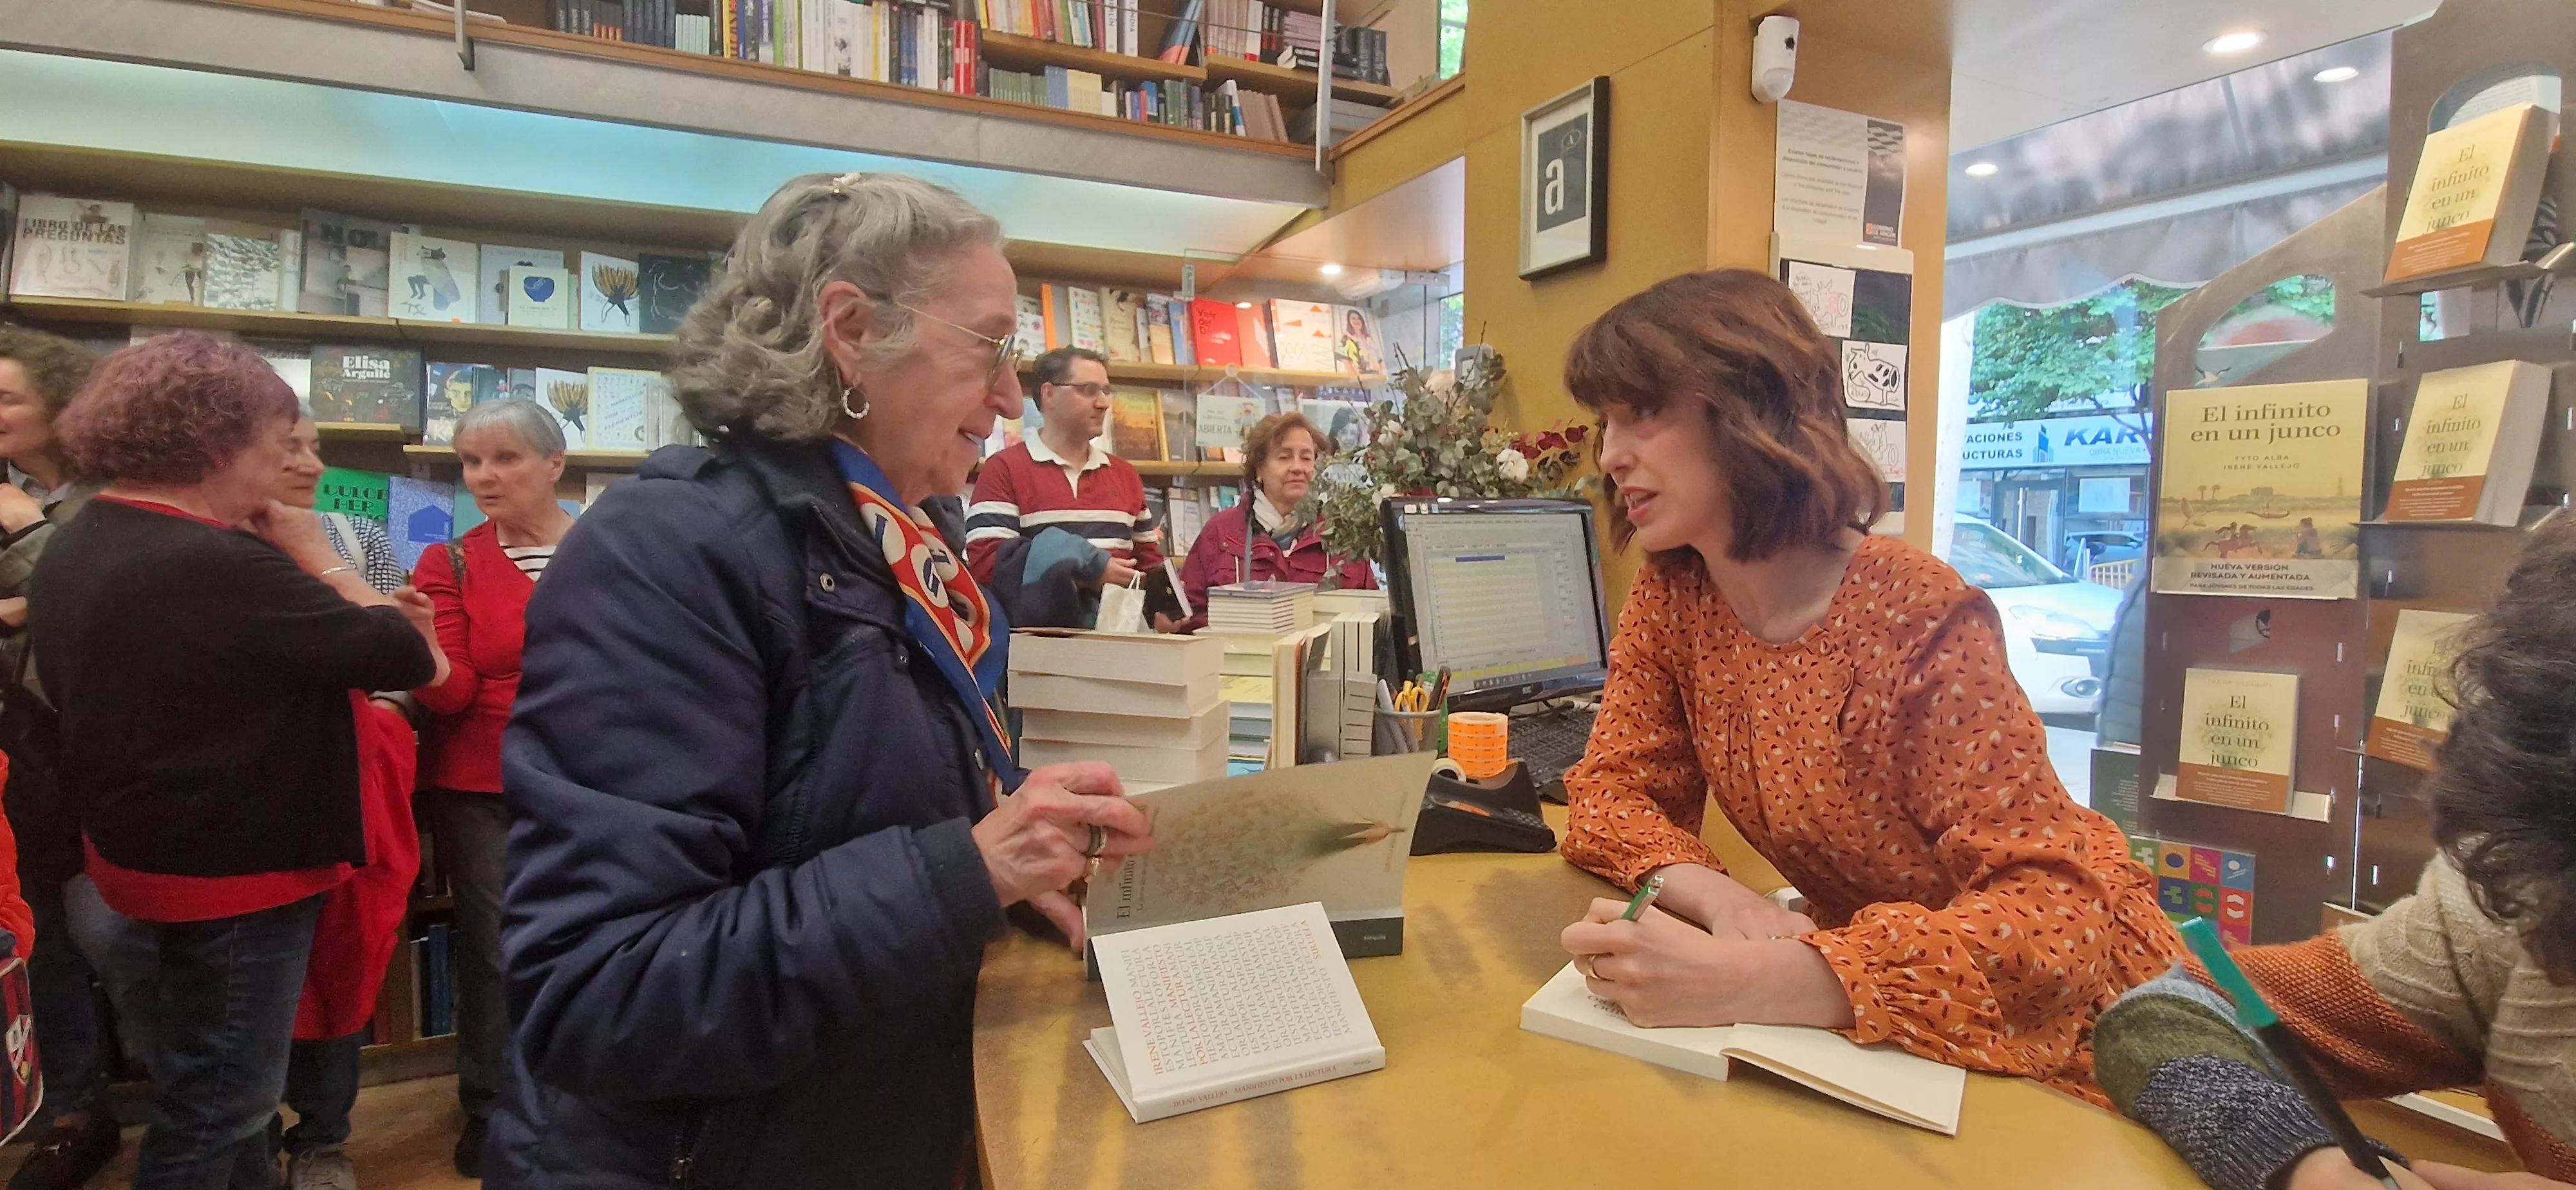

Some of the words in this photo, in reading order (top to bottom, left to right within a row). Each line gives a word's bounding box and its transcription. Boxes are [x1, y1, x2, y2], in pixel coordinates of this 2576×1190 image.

[2459, 144, 2476, 162] El
[1545, 158, 1564, 215] a
[2432, 165, 2489, 191] infinito
[2432, 195, 2450, 209] en
[2455, 189, 2476, 203] un
[99, 223, 126, 237] LAS
[2422, 210, 2469, 234] junco
[23, 227, 126, 245] PREGUNTAS
[343, 355, 390, 370] Elisa
[2452, 393, 2468, 410] El
[2201, 405, 2226, 422] El
[2235, 402, 2331, 422] infinito
[1198, 424, 1233, 434] ABIERTA
[2191, 429, 2219, 442] en
[2228, 428, 2260, 440] un
[2267, 423, 2341, 445] junco
[2426, 417, 2481, 435] infinito
[1965, 431, 2023, 444] ACIONES
[2427, 442, 2445, 454] en
[2449, 441, 2468, 451] un
[2418, 461, 2463, 479] junco
[2246, 562, 2289, 571] VERSIÓN
[2408, 685, 2427, 694] en
[2230, 695, 2246, 709] El
[2206, 713, 2269, 731] infinito
[2211, 735, 2231, 745] en
[2237, 737, 2259, 748] un
[2208, 750, 2258, 768] junco
[1119, 860, 1135, 903] infinito
[1117, 905, 1130, 920] El
[1298, 919, 1321, 959] SIRUELA
[1152, 943, 1180, 1008] MANIFIESTO
[1234, 1078, 1278, 1094] MANIFIESTO
[1304, 1065, 1337, 1080] LECTURA
